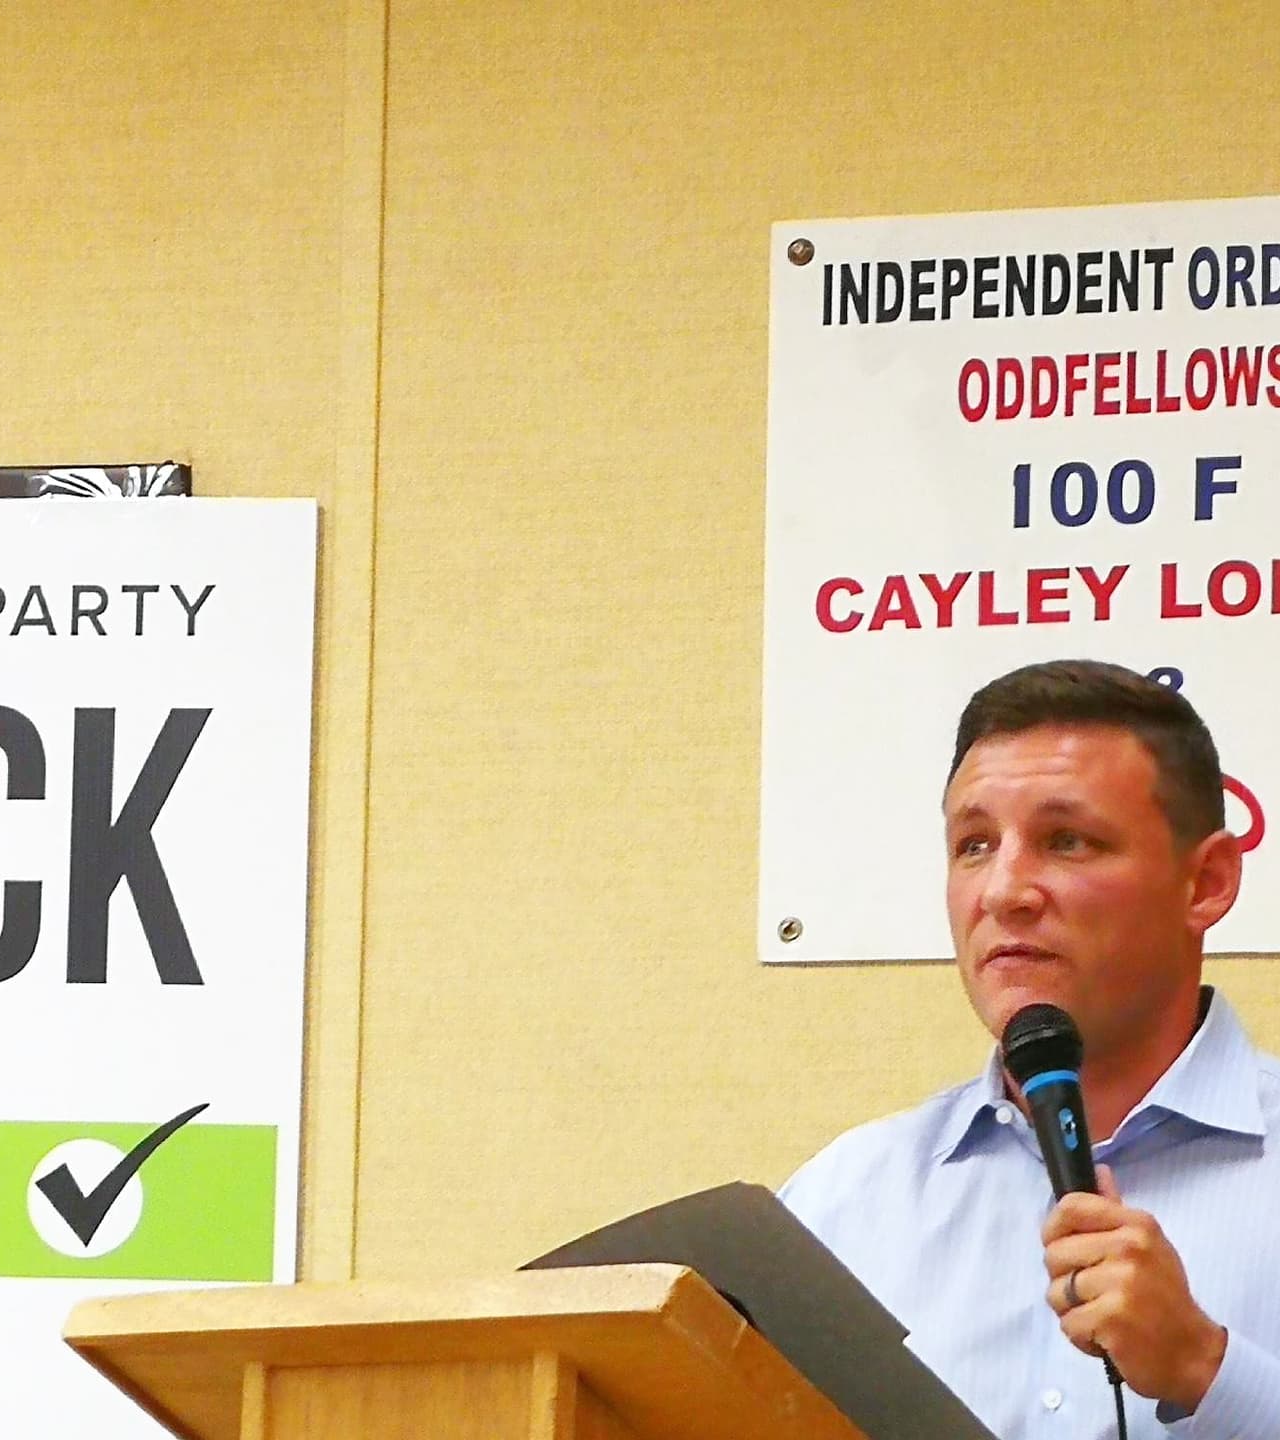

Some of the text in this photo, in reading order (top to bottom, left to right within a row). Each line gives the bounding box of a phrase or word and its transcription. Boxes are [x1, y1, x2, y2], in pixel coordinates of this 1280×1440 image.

[824, 249, 1175, 326] INDEPENDENT
[1014, 457, 1242, 529] 100 F
[817, 566, 1131, 634] CAYLEY
